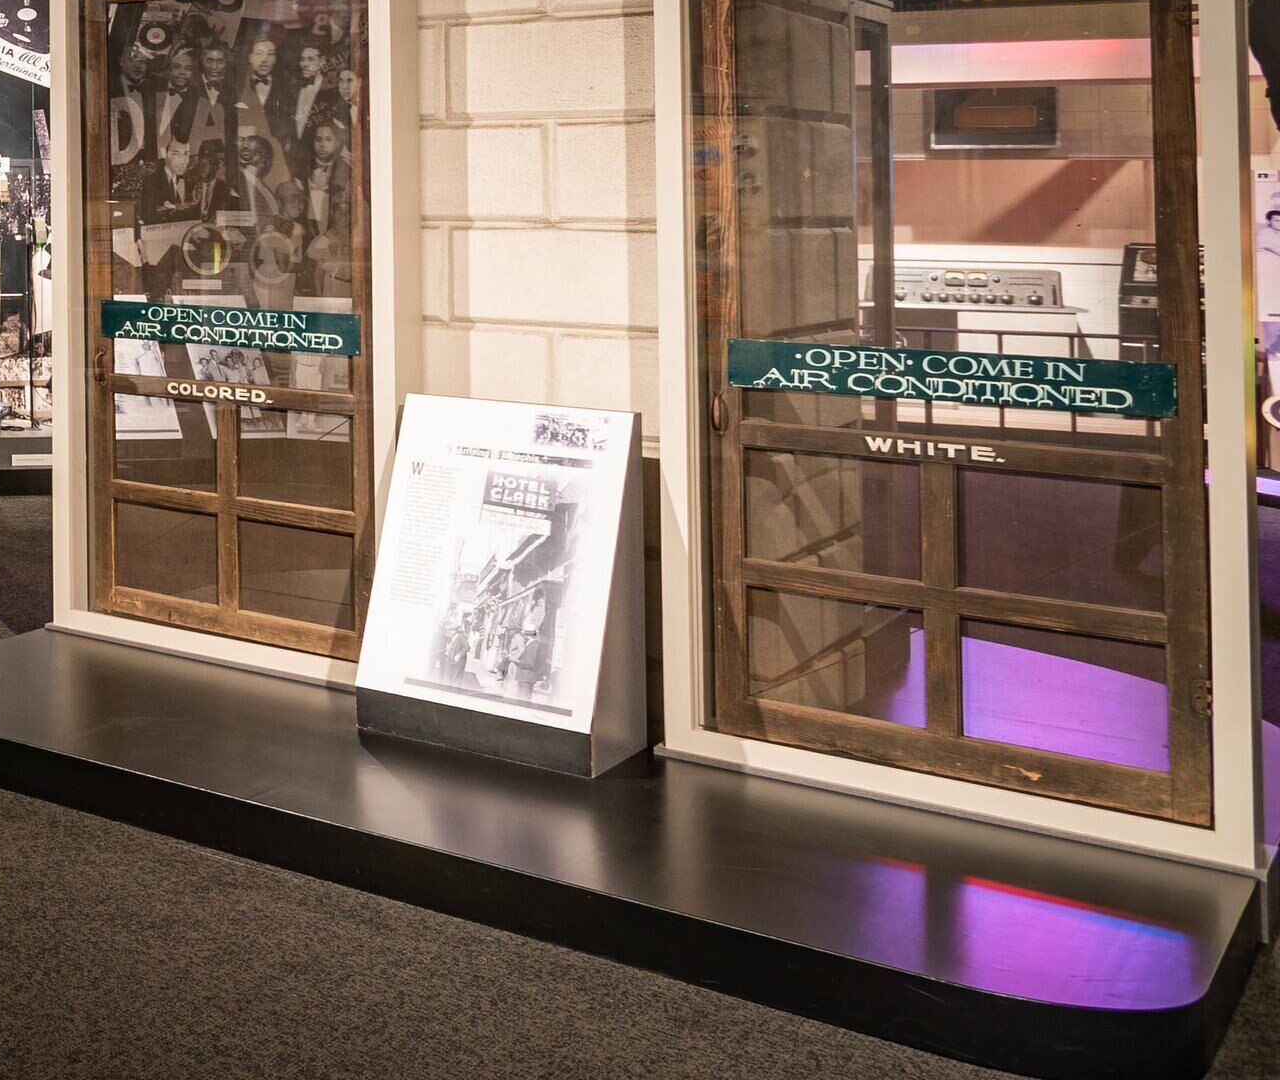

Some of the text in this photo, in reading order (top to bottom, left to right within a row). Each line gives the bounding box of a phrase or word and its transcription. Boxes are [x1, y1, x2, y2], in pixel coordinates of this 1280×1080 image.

[18, 51, 42, 67] All
[210, 309, 279, 328] COME
[283, 313, 308, 330] IN
[171, 323, 344, 353] CONDITIONED
[922, 354, 1034, 381] COME
[1043, 359, 1087, 383] IN
[752, 367, 1134, 411] AIR CONDITIONED
[493, 473, 551, 496] HOTEL
[490, 486, 551, 510] CLARK
